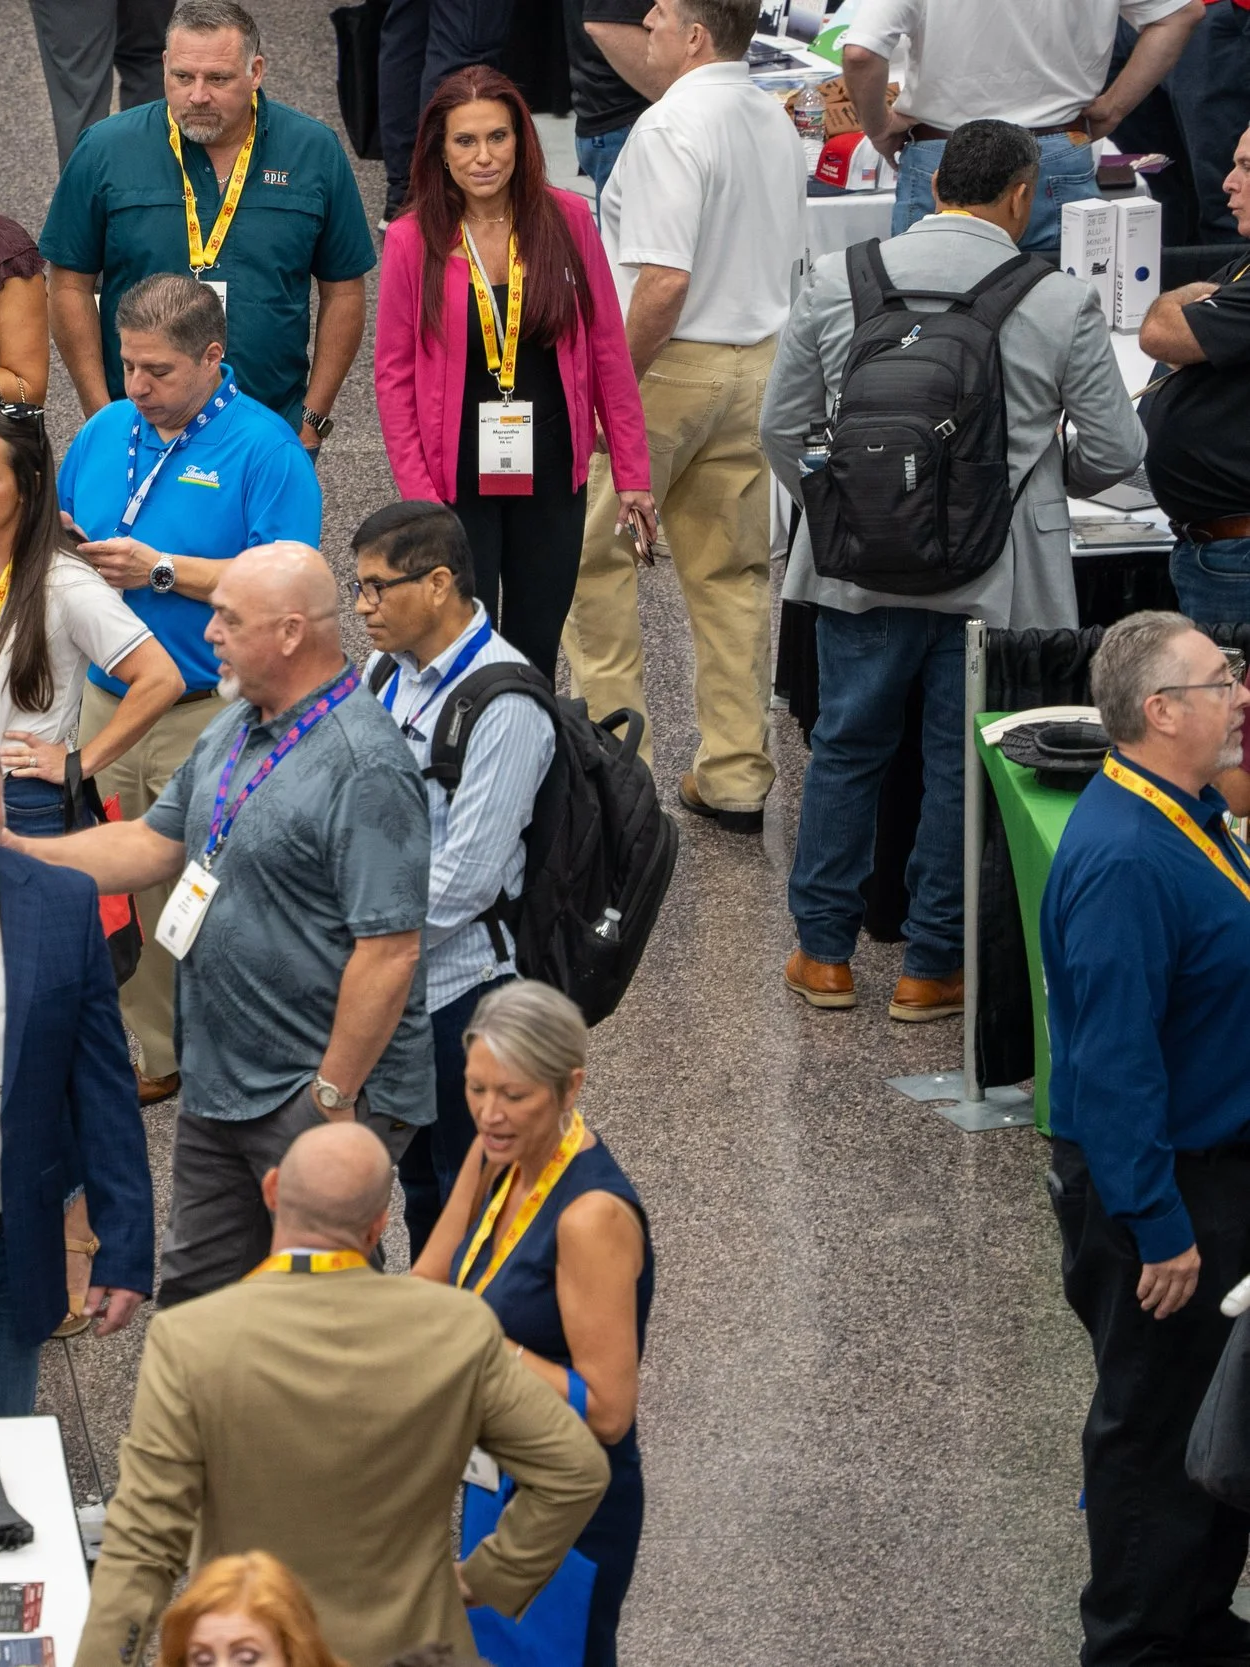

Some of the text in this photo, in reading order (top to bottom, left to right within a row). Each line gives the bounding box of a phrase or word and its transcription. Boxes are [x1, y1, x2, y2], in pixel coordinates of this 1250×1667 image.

[264, 171, 287, 184] epic
[1087, 216, 1107, 227] 28 OZ
[1086, 236, 1111, 247] MINUM
[1086, 246, 1113, 258] BOTTLE
[1116, 270, 1124, 325] SURGE
